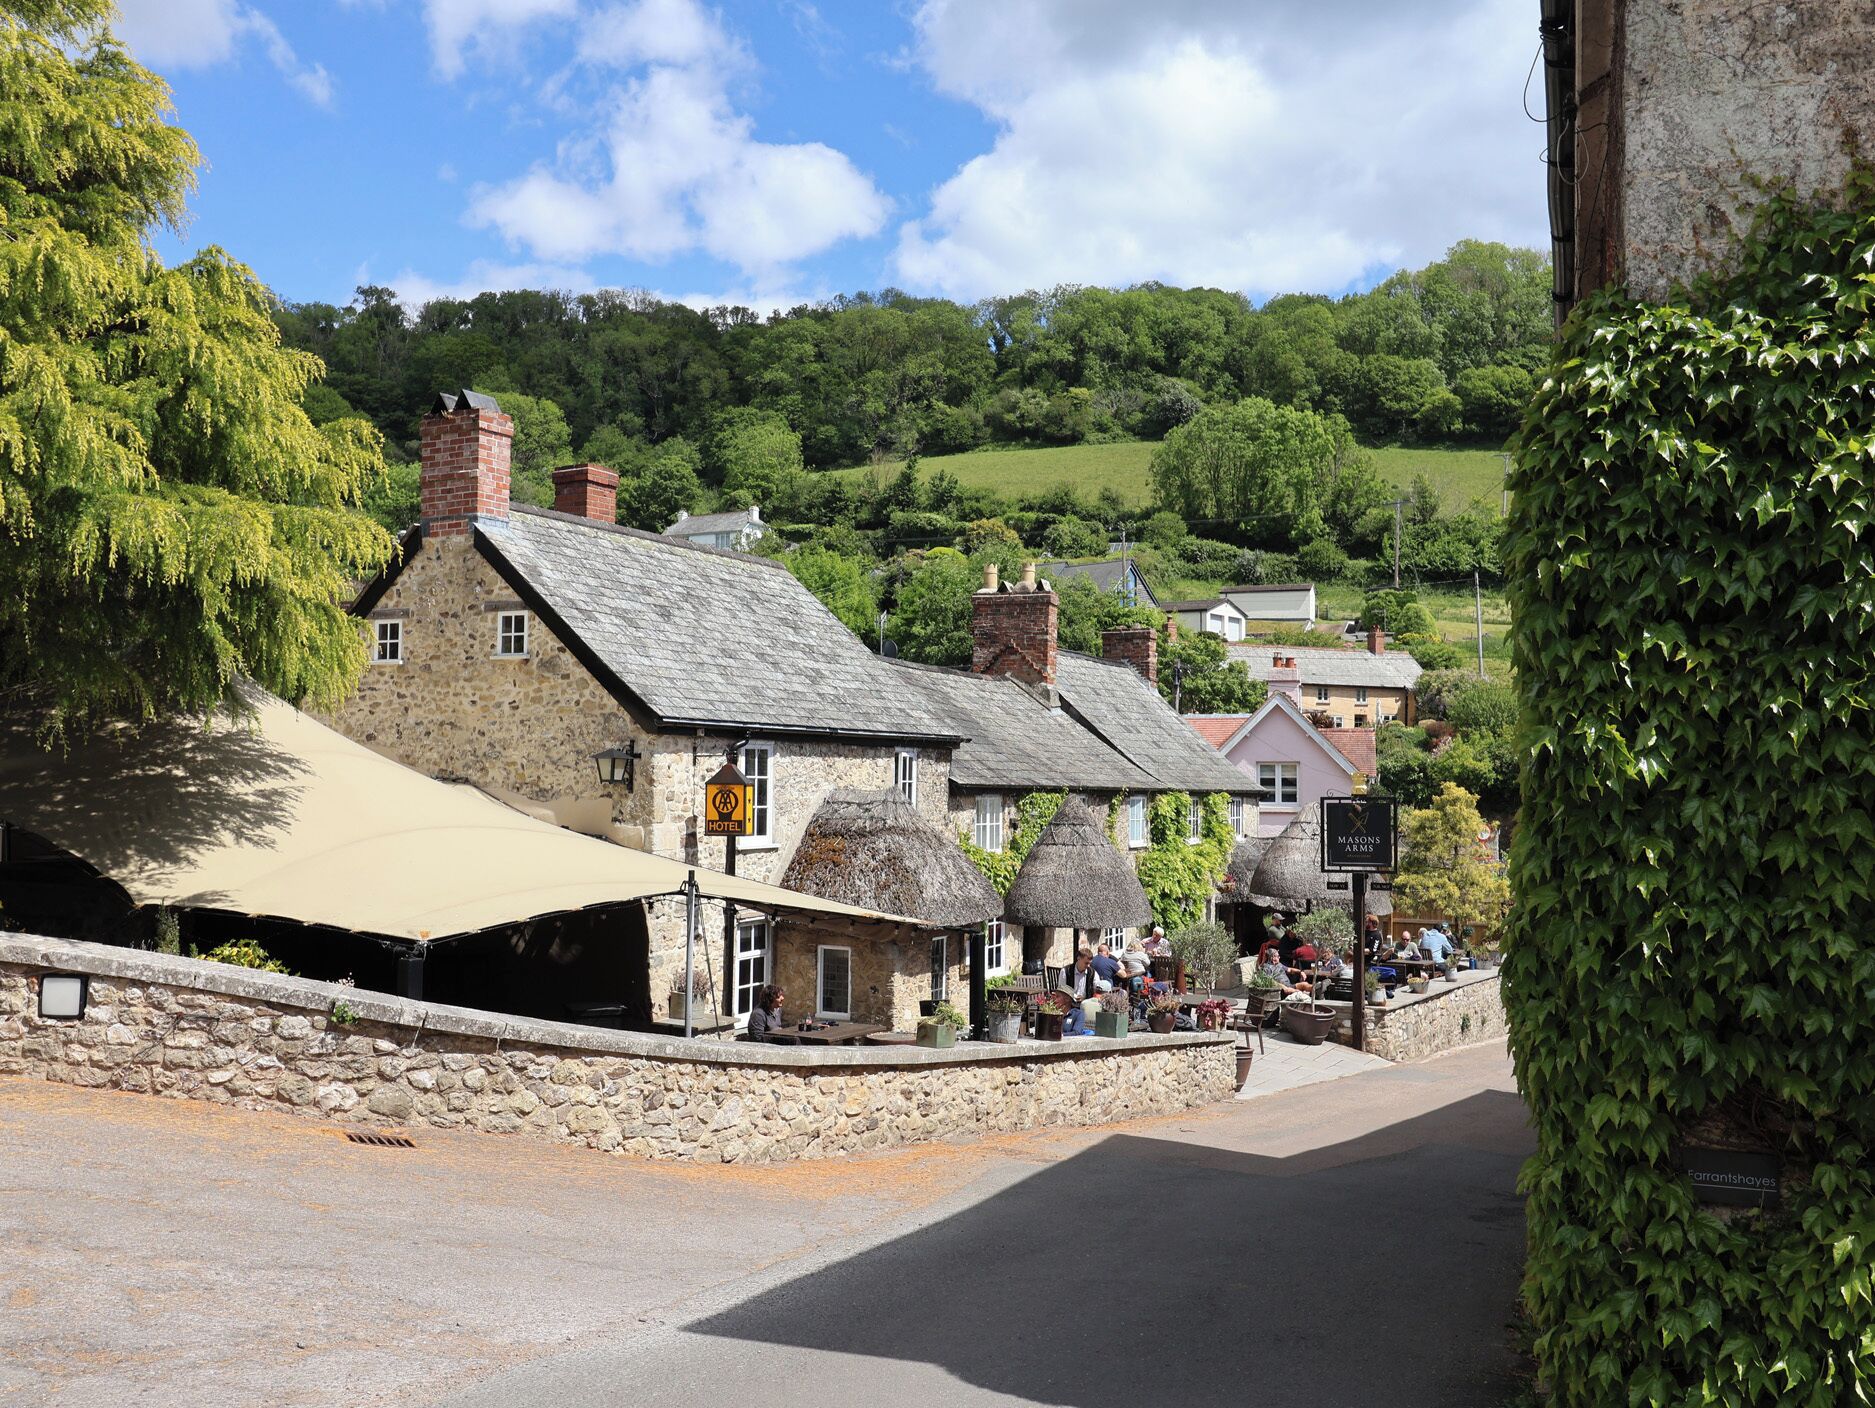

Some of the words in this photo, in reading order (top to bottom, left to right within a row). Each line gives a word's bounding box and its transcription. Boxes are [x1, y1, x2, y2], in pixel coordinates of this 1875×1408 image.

[709, 821, 741, 831] HOTEL
[1337, 836, 1381, 844] MASONS
[1345, 844, 1374, 852] ARMS
[1688, 1169, 1776, 1187] Farrantshayes
